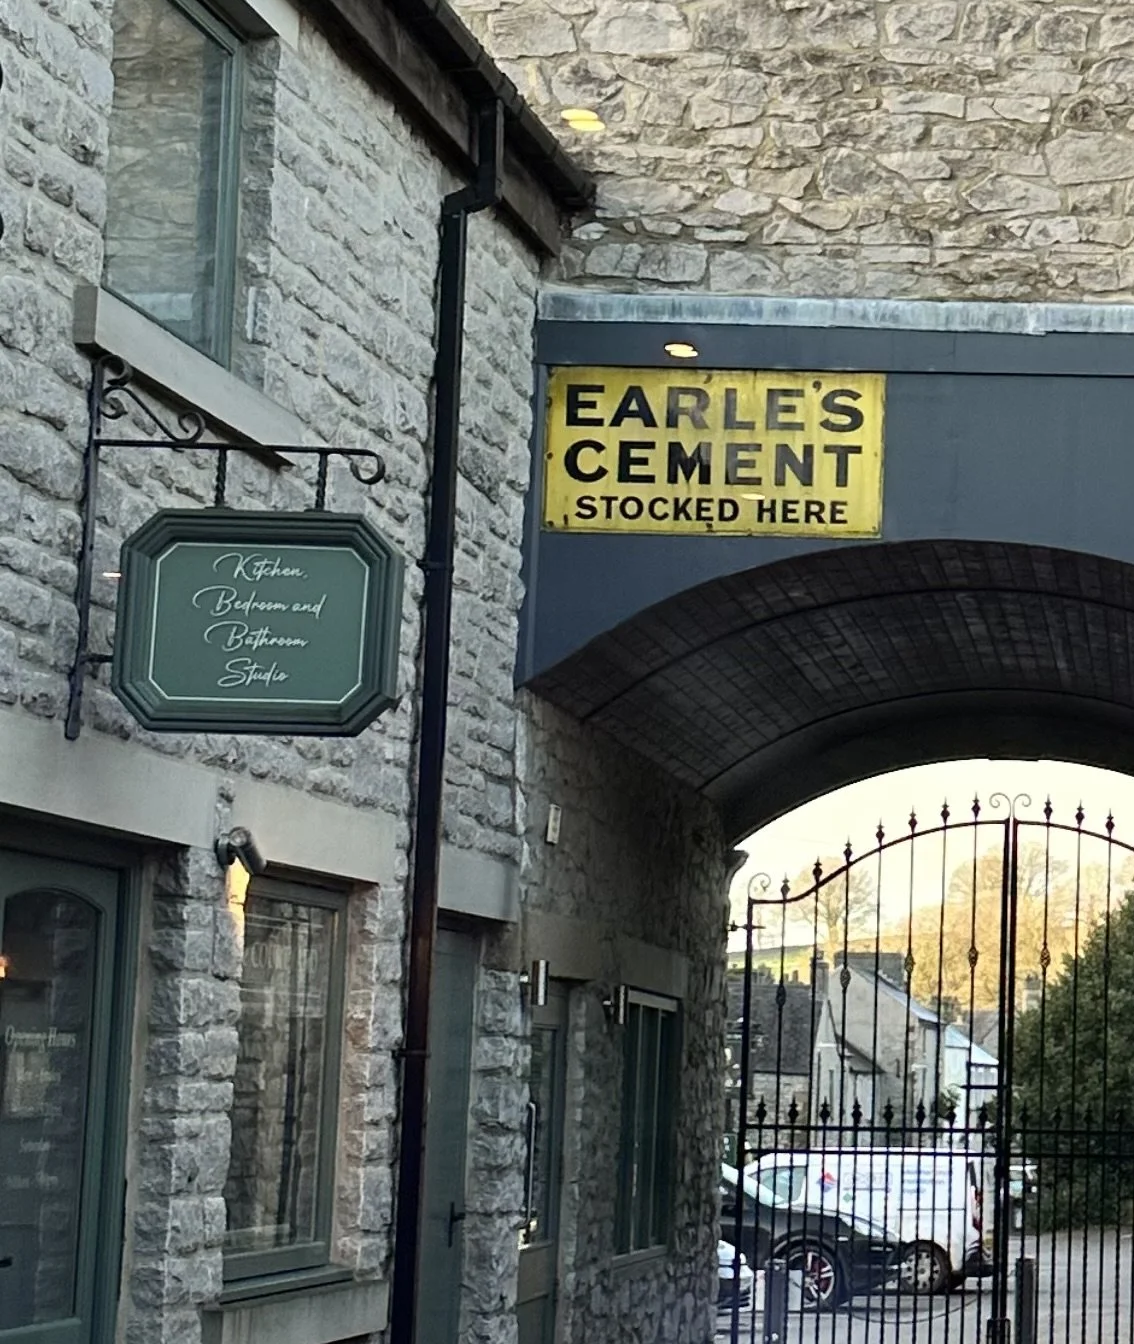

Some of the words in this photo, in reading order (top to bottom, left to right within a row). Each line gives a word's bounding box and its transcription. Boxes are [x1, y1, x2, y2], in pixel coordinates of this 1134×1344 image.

[565, 380, 864, 433] EARLE'S
[563, 439, 863, 488] CEMENT
[575, 495, 740, 523] STOCKED
[756, 498, 849, 525] HERE
[212, 552, 309, 581] Kitchen,
[192, 585, 289, 617] Bedroom
[291, 594, 327, 619] and
[203, 621, 310, 652] Bathroom
[216, 657, 290, 688] Studio
